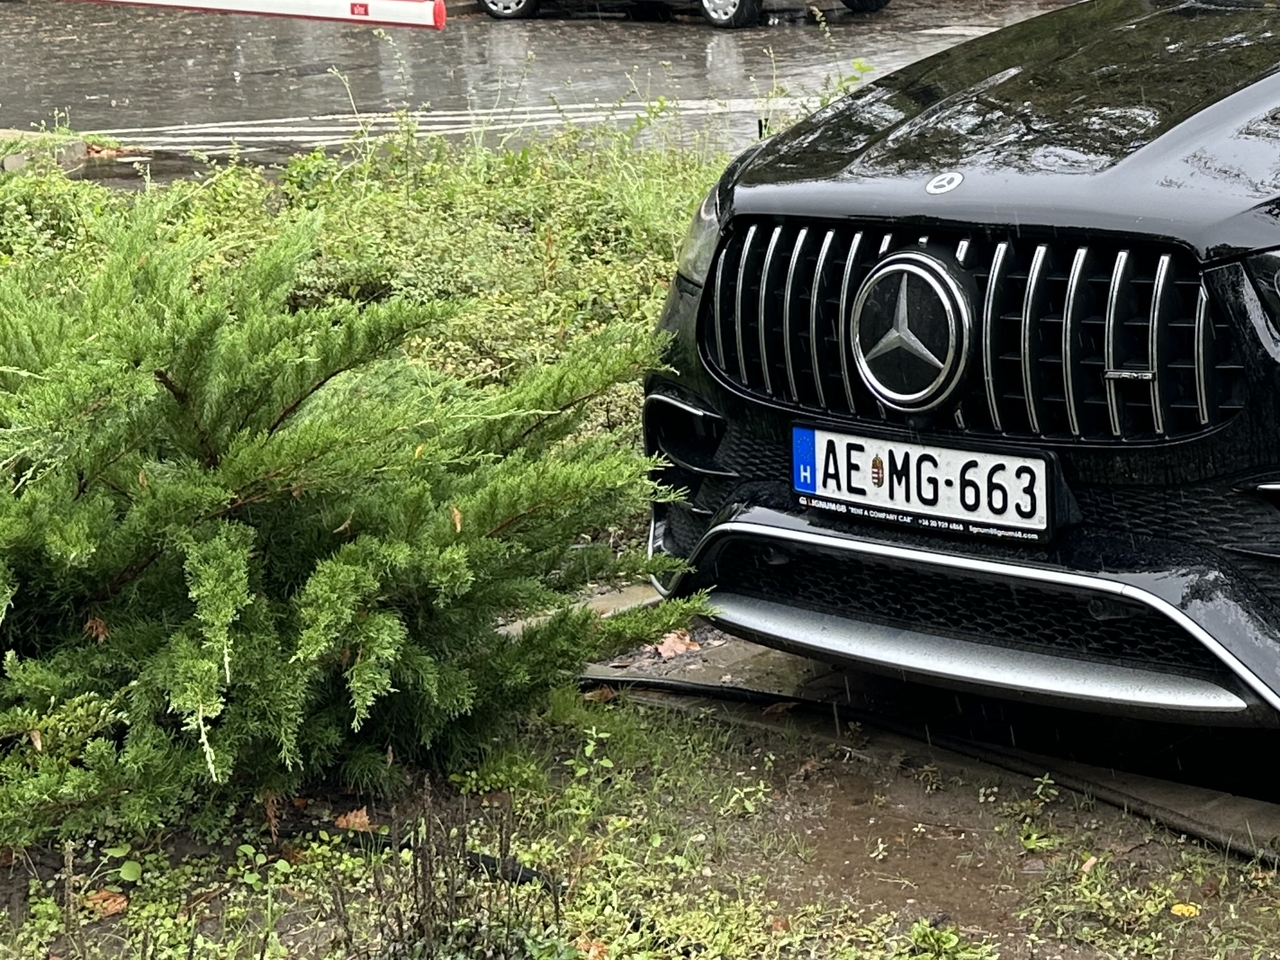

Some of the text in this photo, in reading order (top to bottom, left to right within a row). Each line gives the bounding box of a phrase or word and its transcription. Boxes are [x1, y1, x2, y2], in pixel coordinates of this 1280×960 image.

[1119, 371, 1153, 380] AMG
[799, 464, 811, 485] H
[821, 438, 867, 496] AE
